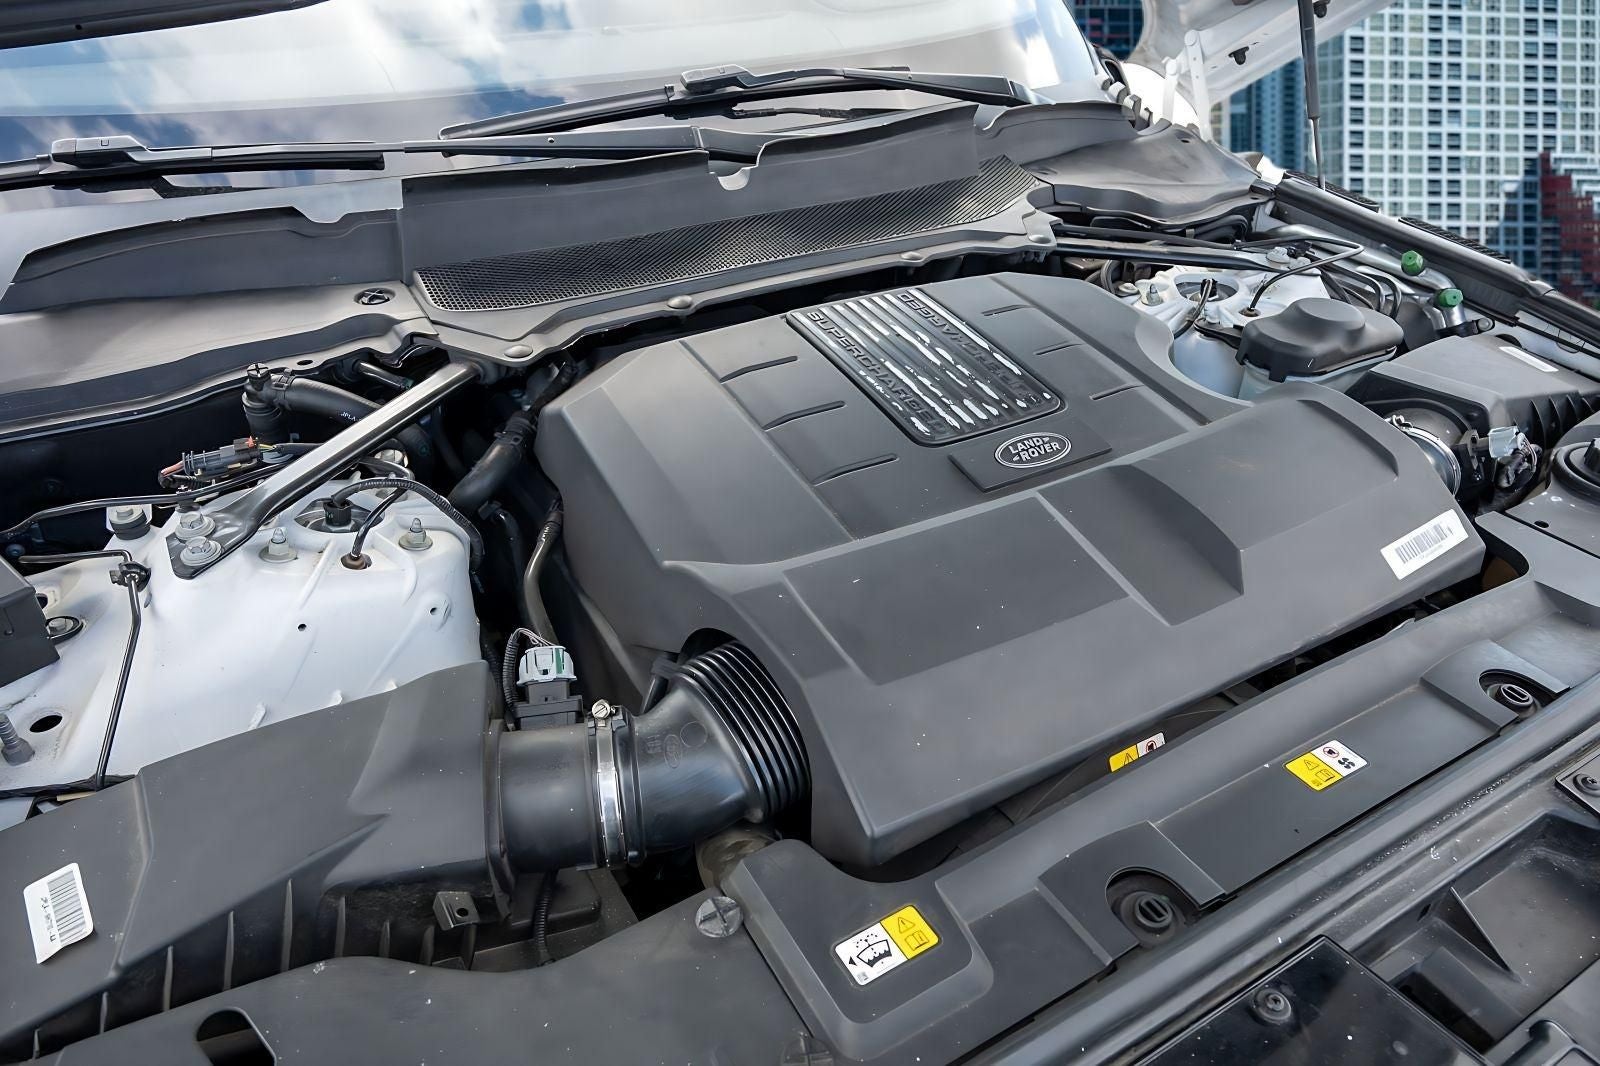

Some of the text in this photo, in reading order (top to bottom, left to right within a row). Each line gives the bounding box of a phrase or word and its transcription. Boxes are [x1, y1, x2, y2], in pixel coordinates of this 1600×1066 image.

[806, 310, 947, 435] SUPERCHARGED
[1008, 437, 1043, 454] LAND
[1019, 441, 1061, 461] ROVER
